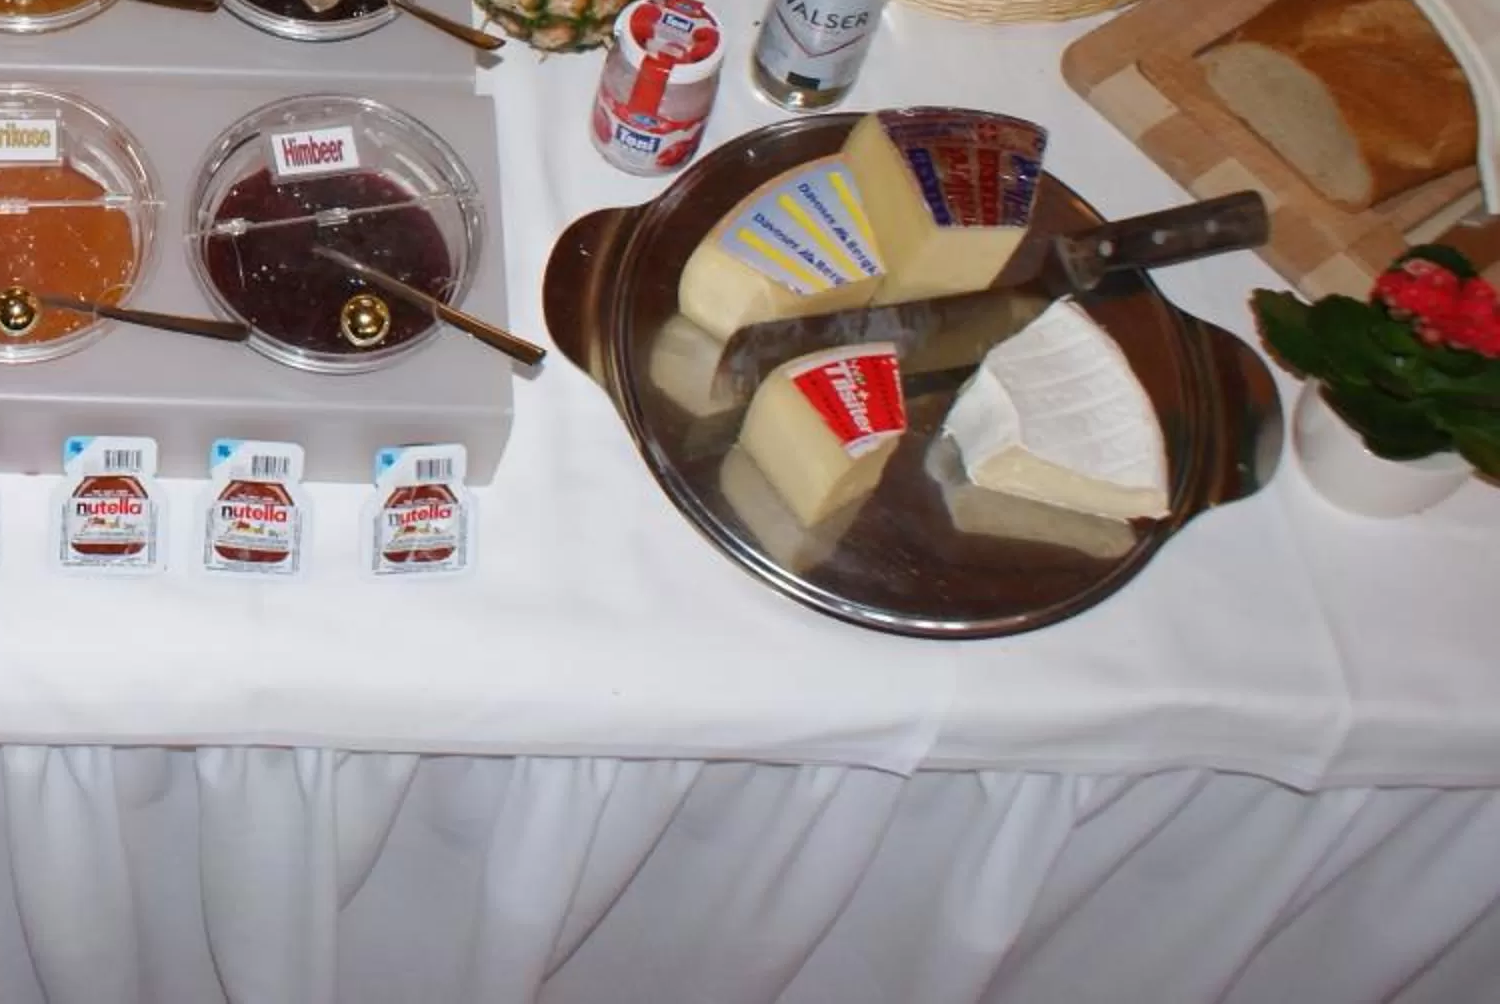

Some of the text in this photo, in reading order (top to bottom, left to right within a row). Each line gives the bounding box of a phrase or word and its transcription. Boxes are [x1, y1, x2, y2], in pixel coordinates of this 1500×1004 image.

[281, 135, 344, 168] Himbeer
[76, 498, 141, 516] nutella
[221, 503, 287, 523] nutella
[388, 503, 452, 527] nutella
